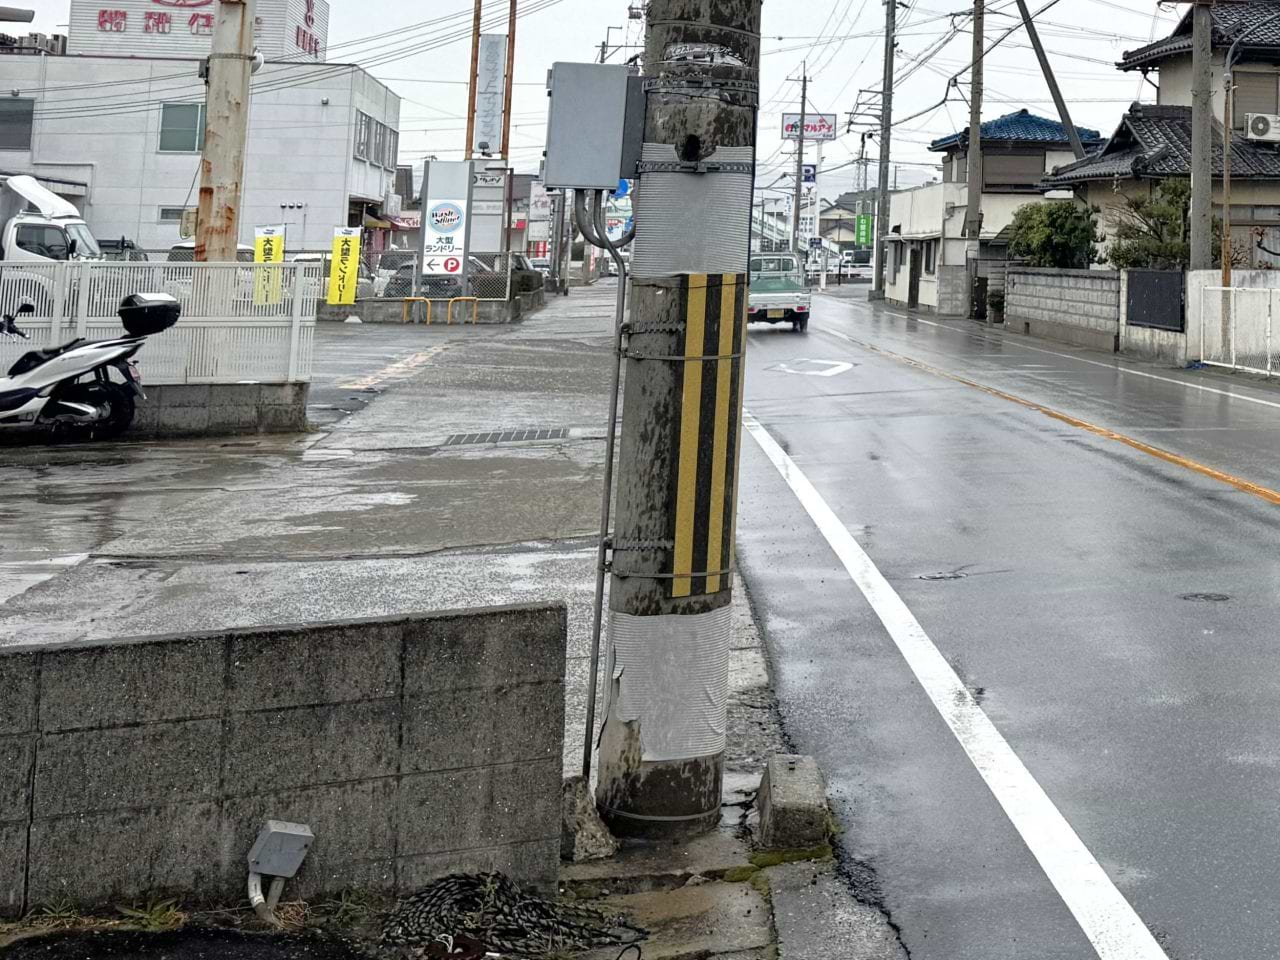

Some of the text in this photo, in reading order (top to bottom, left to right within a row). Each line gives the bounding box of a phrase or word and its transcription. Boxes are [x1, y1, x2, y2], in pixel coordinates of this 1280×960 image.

[436, 236, 453, 245] 大型
[425, 244, 463, 253] ランドリー
